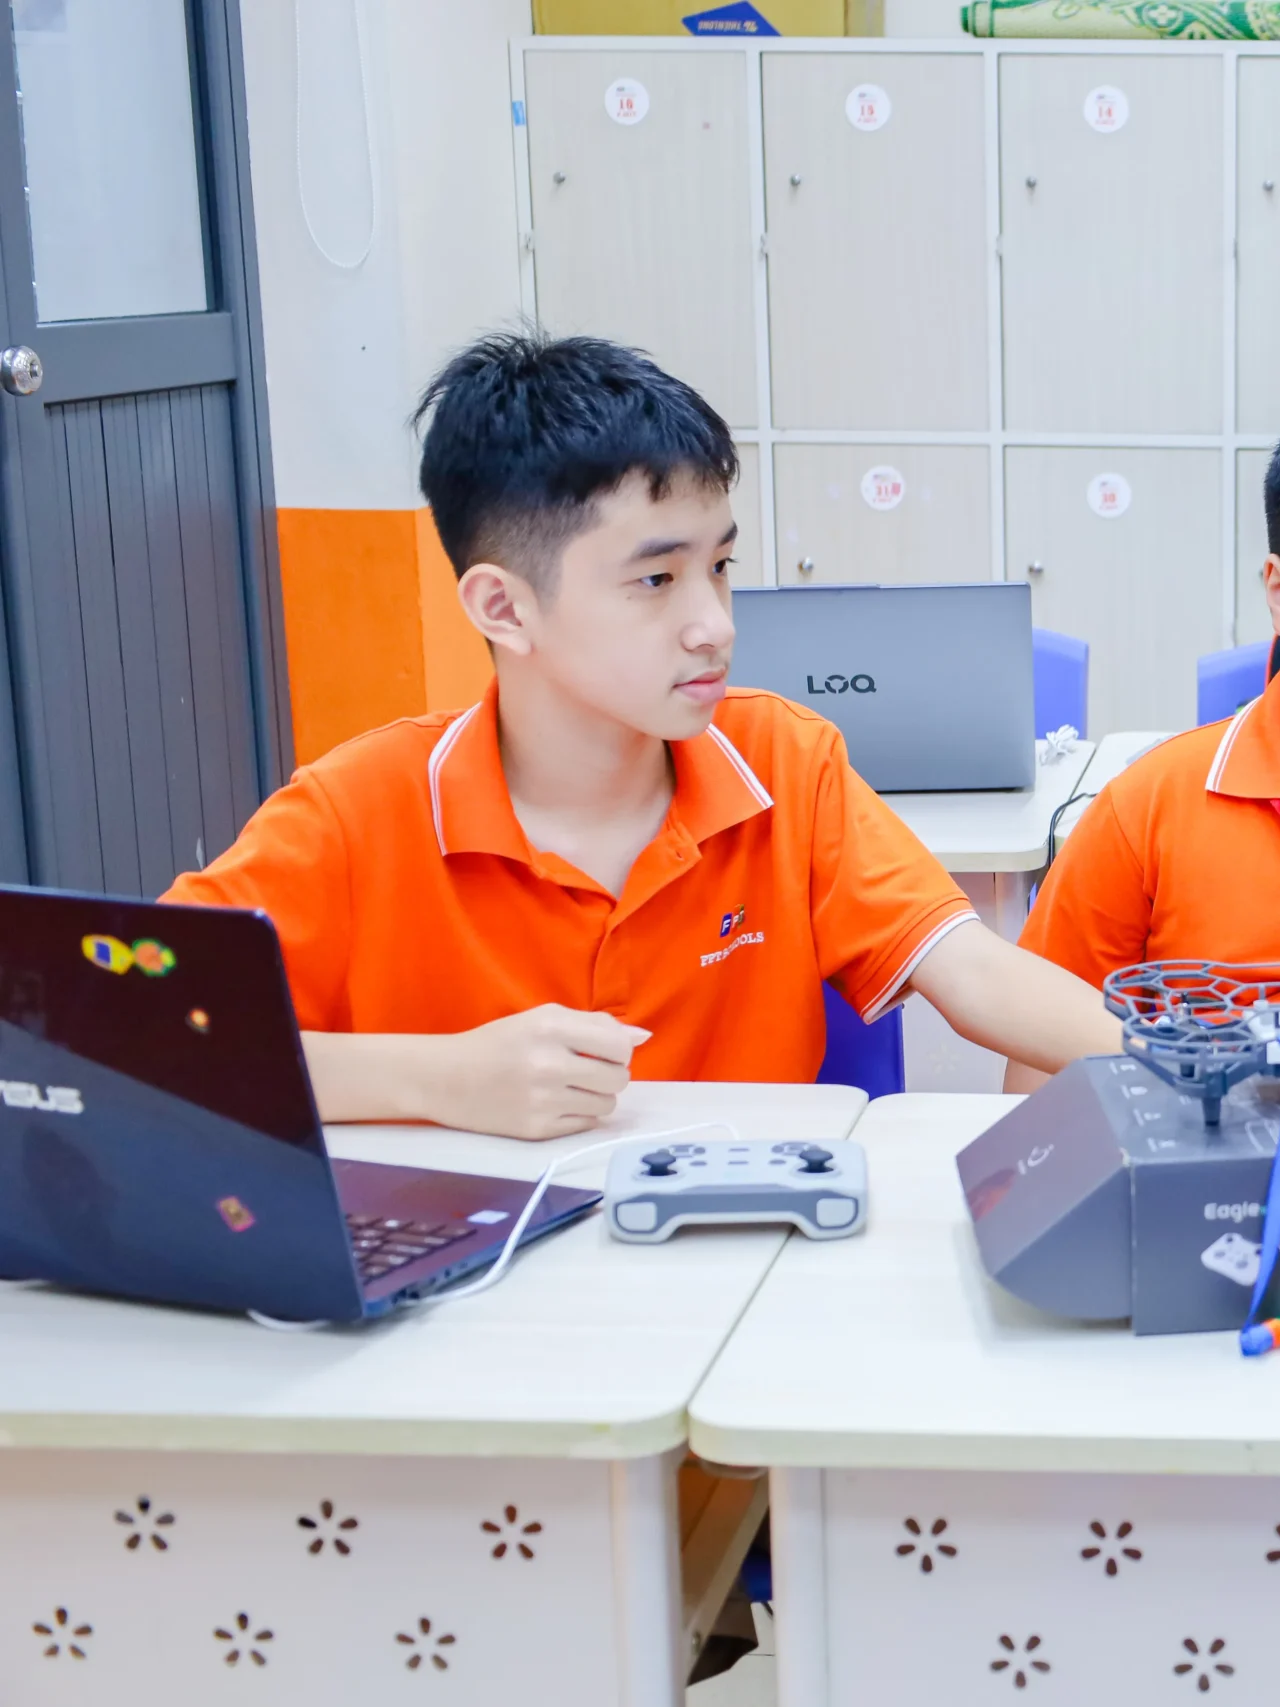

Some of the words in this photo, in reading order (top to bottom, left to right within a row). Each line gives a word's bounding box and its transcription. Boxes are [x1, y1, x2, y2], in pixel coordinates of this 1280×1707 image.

[807, 674, 877, 694] LOQ
[0, 1079, 85, 1115] SUS
[1203, 1200, 1260, 1224] Eagle
